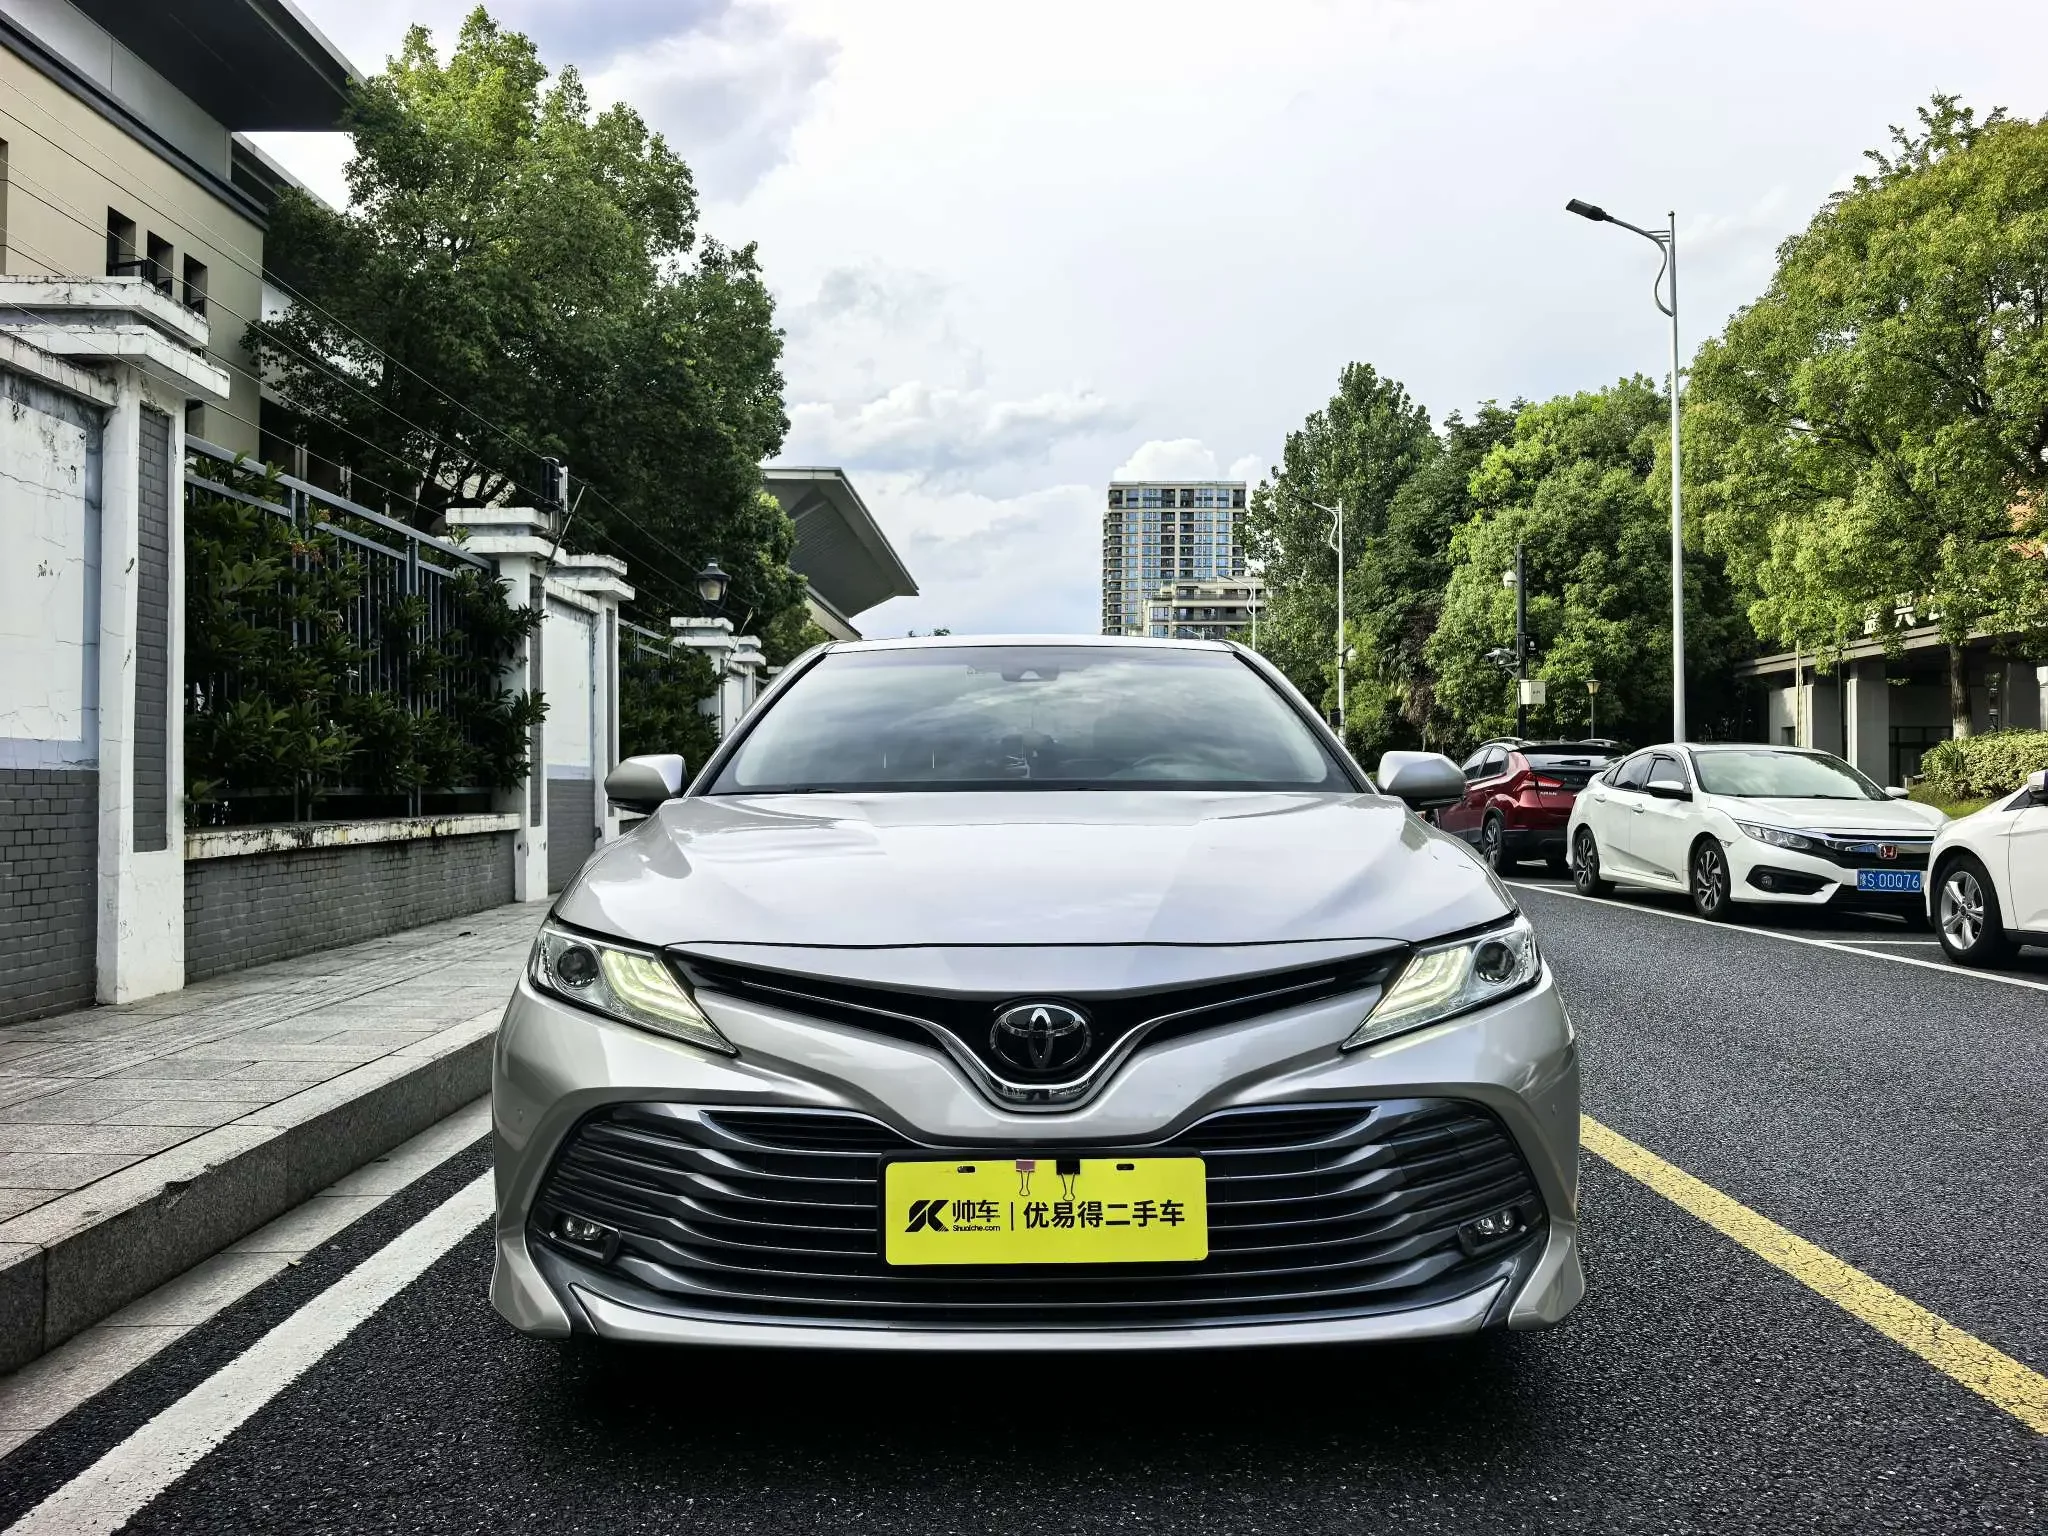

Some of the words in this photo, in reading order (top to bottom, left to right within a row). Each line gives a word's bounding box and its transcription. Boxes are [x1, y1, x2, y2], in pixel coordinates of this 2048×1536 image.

[952, 1199, 1000, 1223] 帅车
[1023, 1199, 1185, 1230] 优易得二手车
